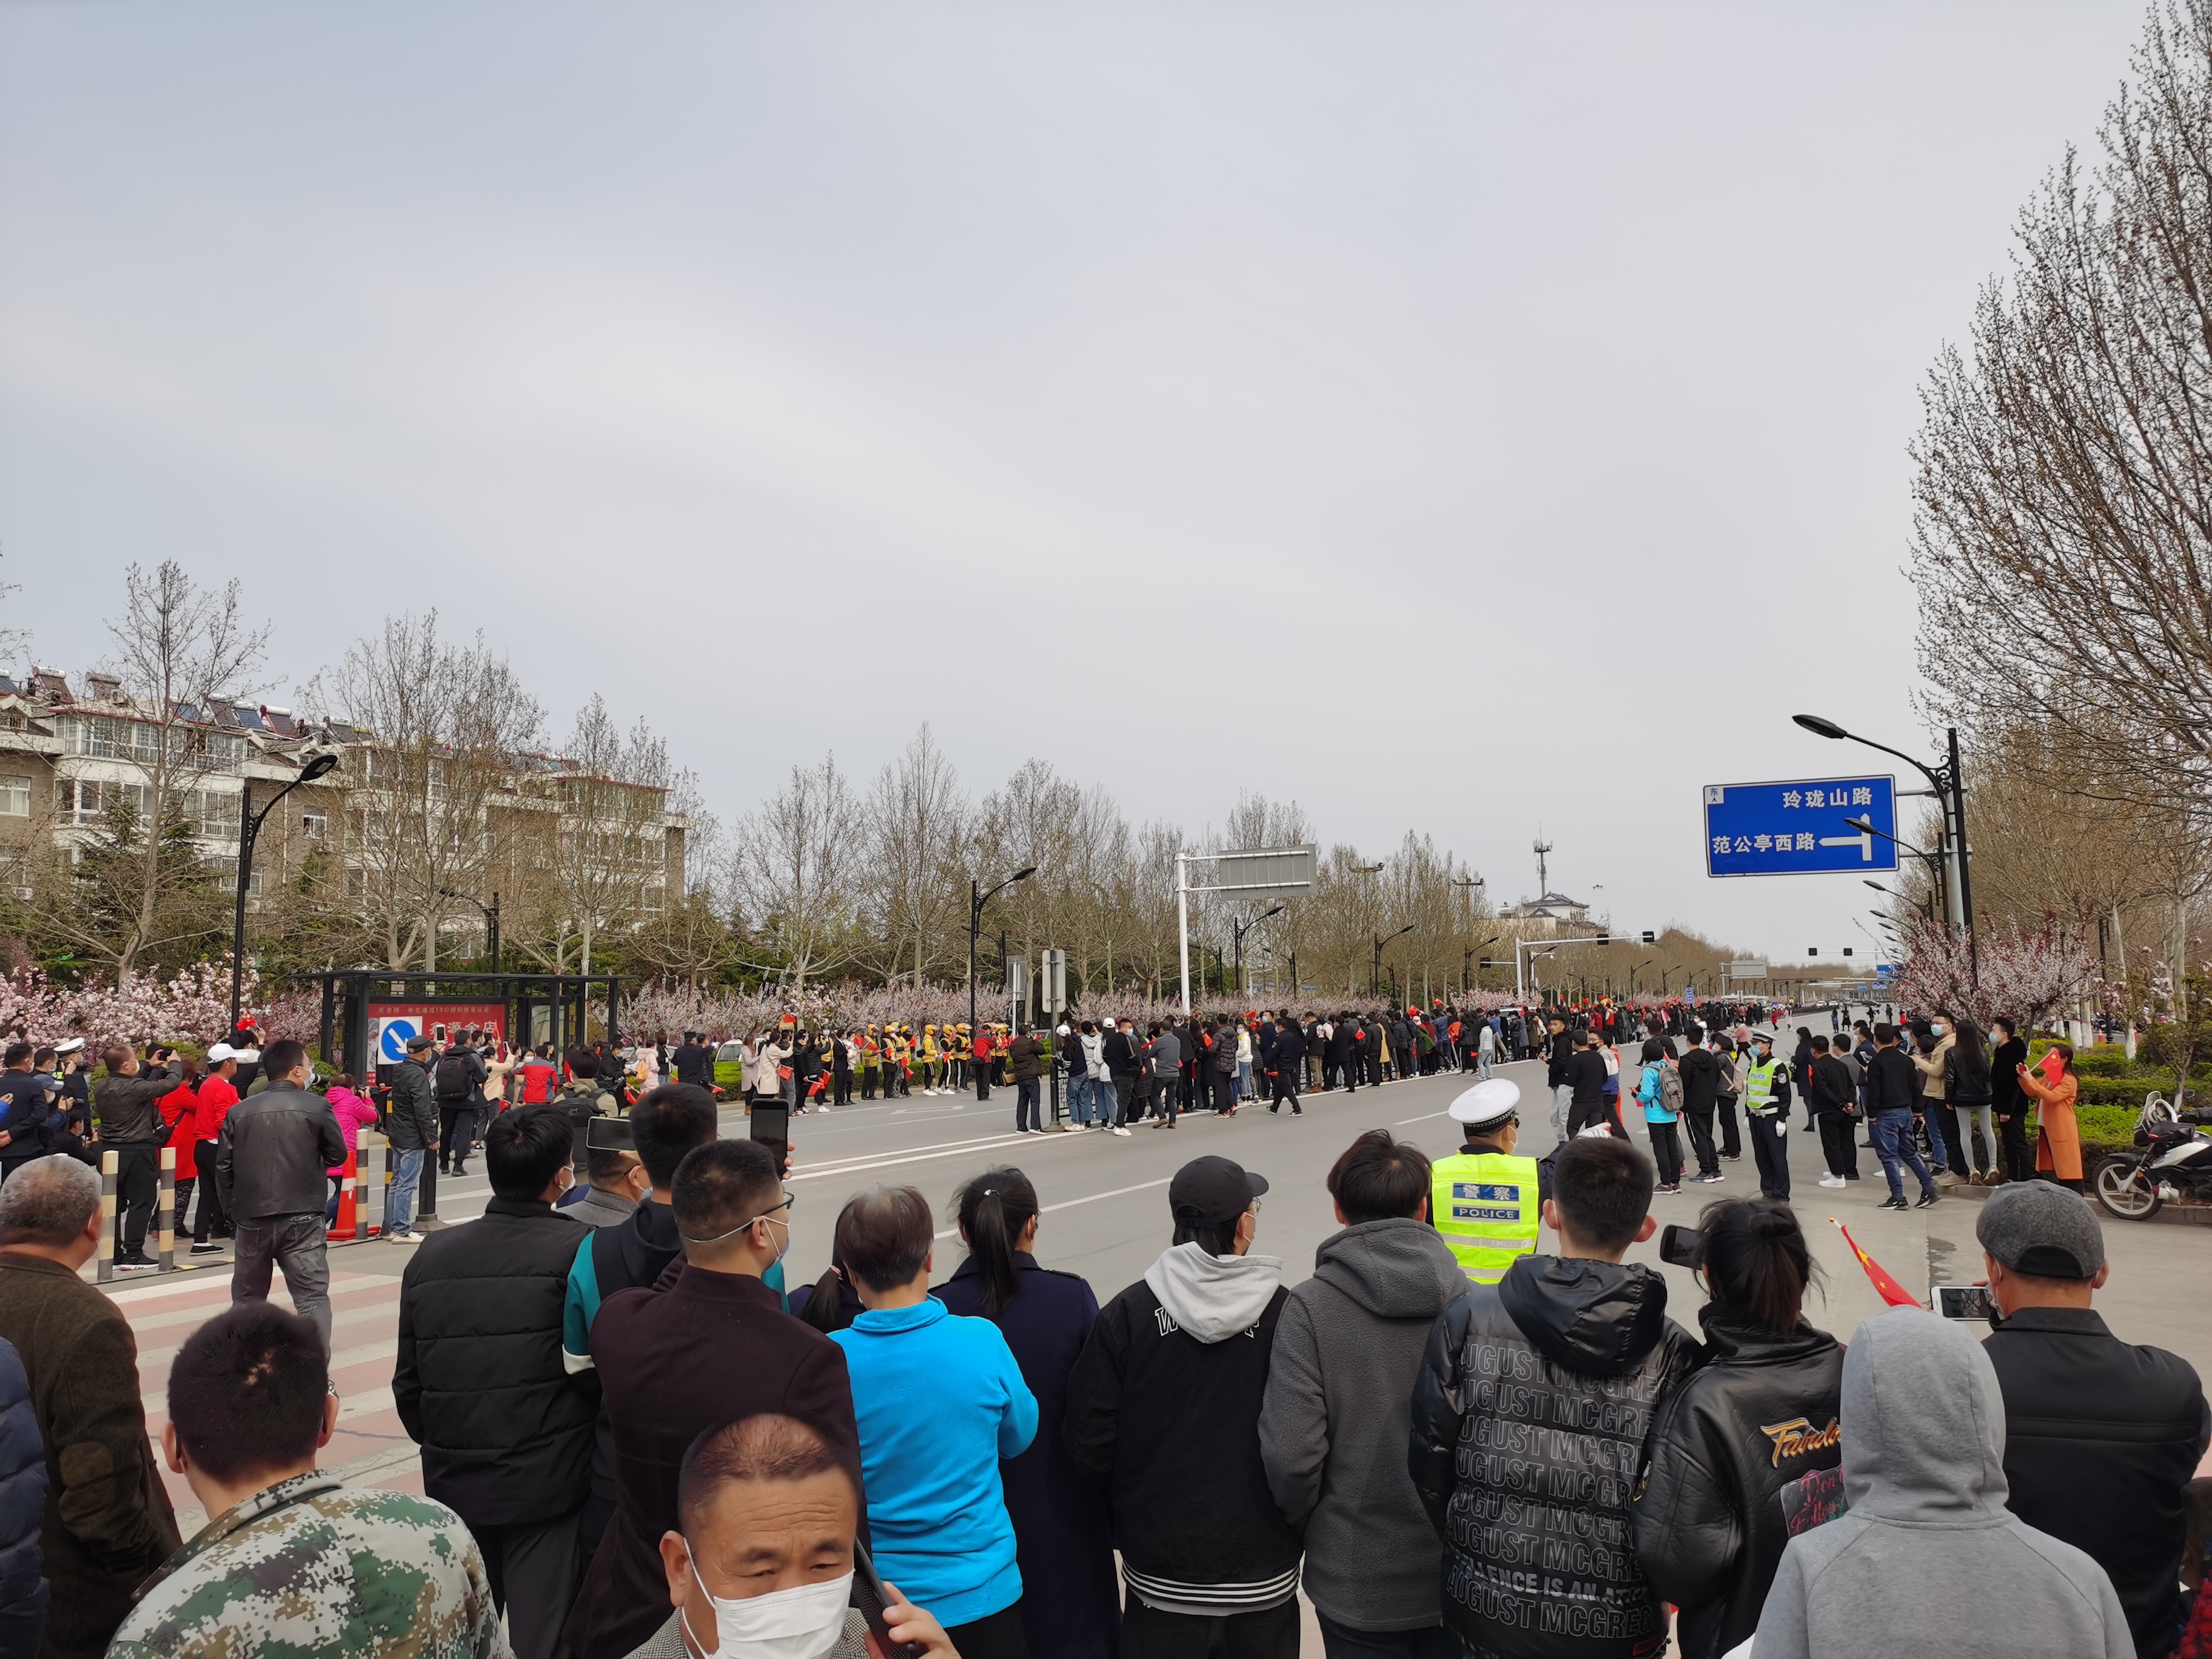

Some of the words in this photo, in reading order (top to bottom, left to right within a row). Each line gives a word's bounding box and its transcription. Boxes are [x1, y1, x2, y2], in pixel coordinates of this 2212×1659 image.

[1709, 788, 1718, 796] 东
[1782, 786, 1873, 808] 玲珑山路
[1712, 832, 1815, 854] 范公亭西路
[1463, 1184, 1510, 1200] 警察
[1459, 1208, 1515, 1219] POLICE
[1550, 1429, 1642, 1475] MCGR
[1548, 1466, 1635, 1511] MCGR
[1545, 1501, 1634, 1549] MCGR
[1543, 1576, 1564, 1597] IS
[1568, 1581, 1597, 1601] AN
[1540, 1601, 1657, 1638] MCGREG
